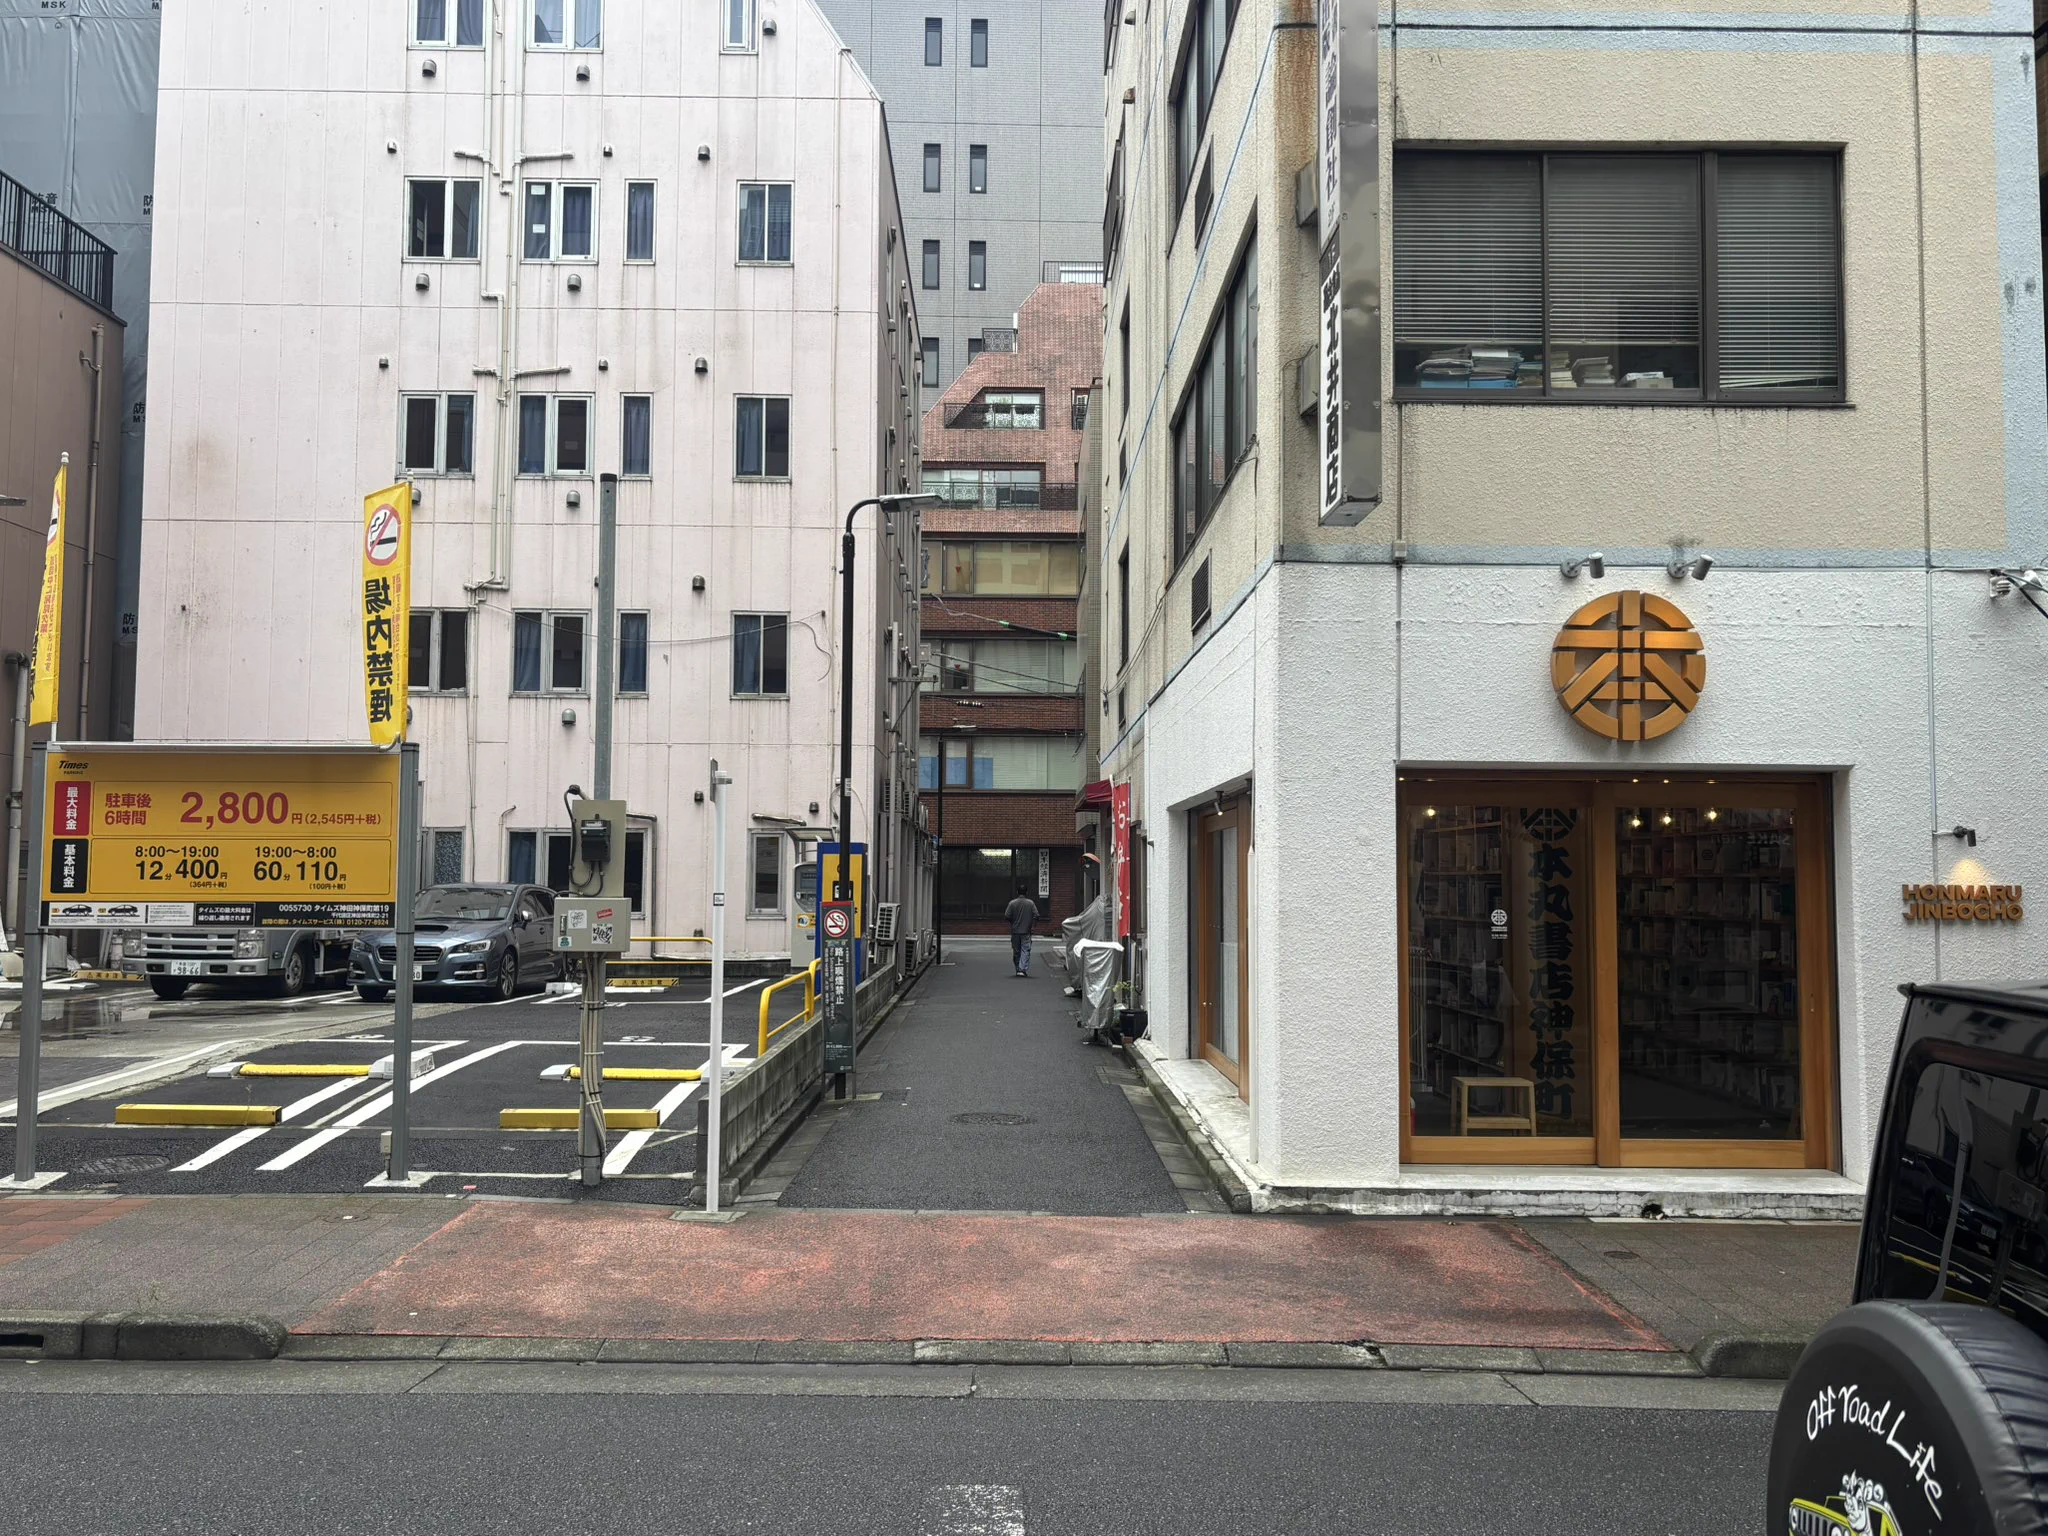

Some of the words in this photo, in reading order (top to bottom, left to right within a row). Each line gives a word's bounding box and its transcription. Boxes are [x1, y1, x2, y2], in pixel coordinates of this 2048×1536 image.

[41, 1, 67, 9] MSK
[1325, 302, 1341, 509] 北井商店
[58, 760, 89, 770] Times
[65, 787, 79, 830] 最大料金
[105, 793, 152, 809] 駐車後
[105, 810, 147, 826] 6時間
[63, 844, 77, 888] 基本料金
[1902, 884, 2023, 903] HONMARU
[1903, 903, 2024, 921] JINBOCHO
[834, 947, 845, 1005] 路上喫煙禁止
[1528, 843, 1575, 1120] 本丸書店神保町
[1806, 1385, 1836, 1441] Off
[1886, 1410, 1943, 1522] Life
